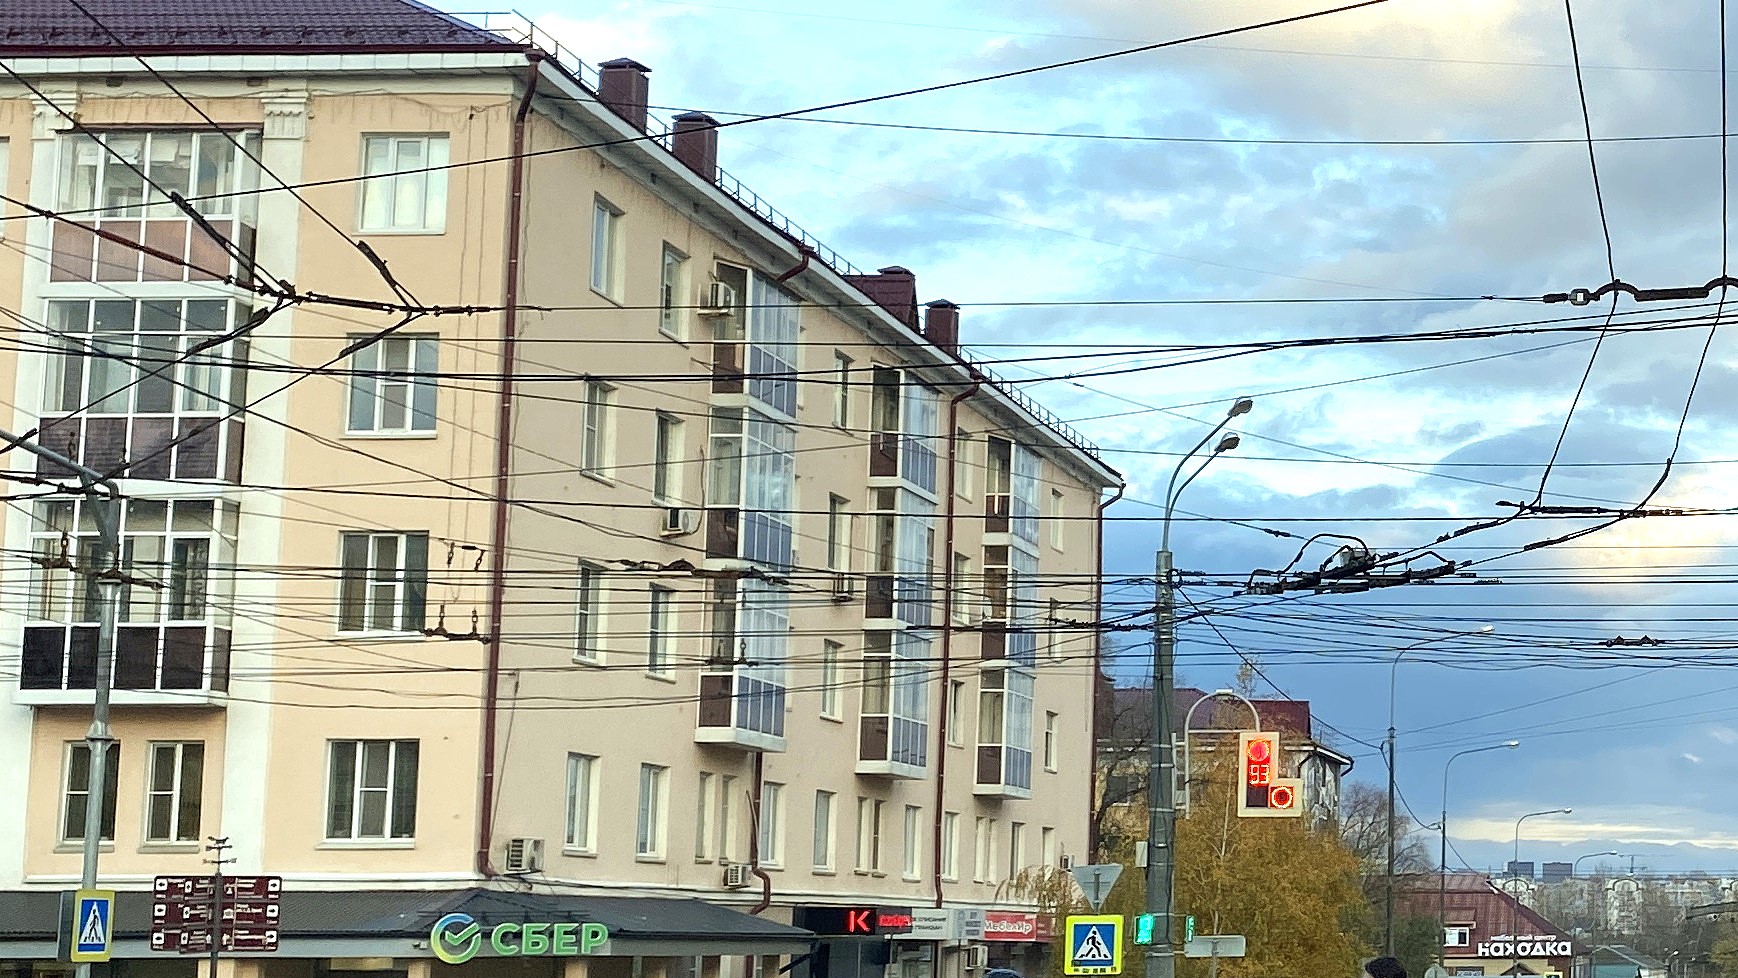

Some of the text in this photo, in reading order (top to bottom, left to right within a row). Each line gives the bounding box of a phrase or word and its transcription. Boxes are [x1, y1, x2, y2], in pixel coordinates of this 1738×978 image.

[1249, 764, 1270, 785] 93
[849, 910, 871, 932] К
[491, 922, 609, 956] СБЕР
